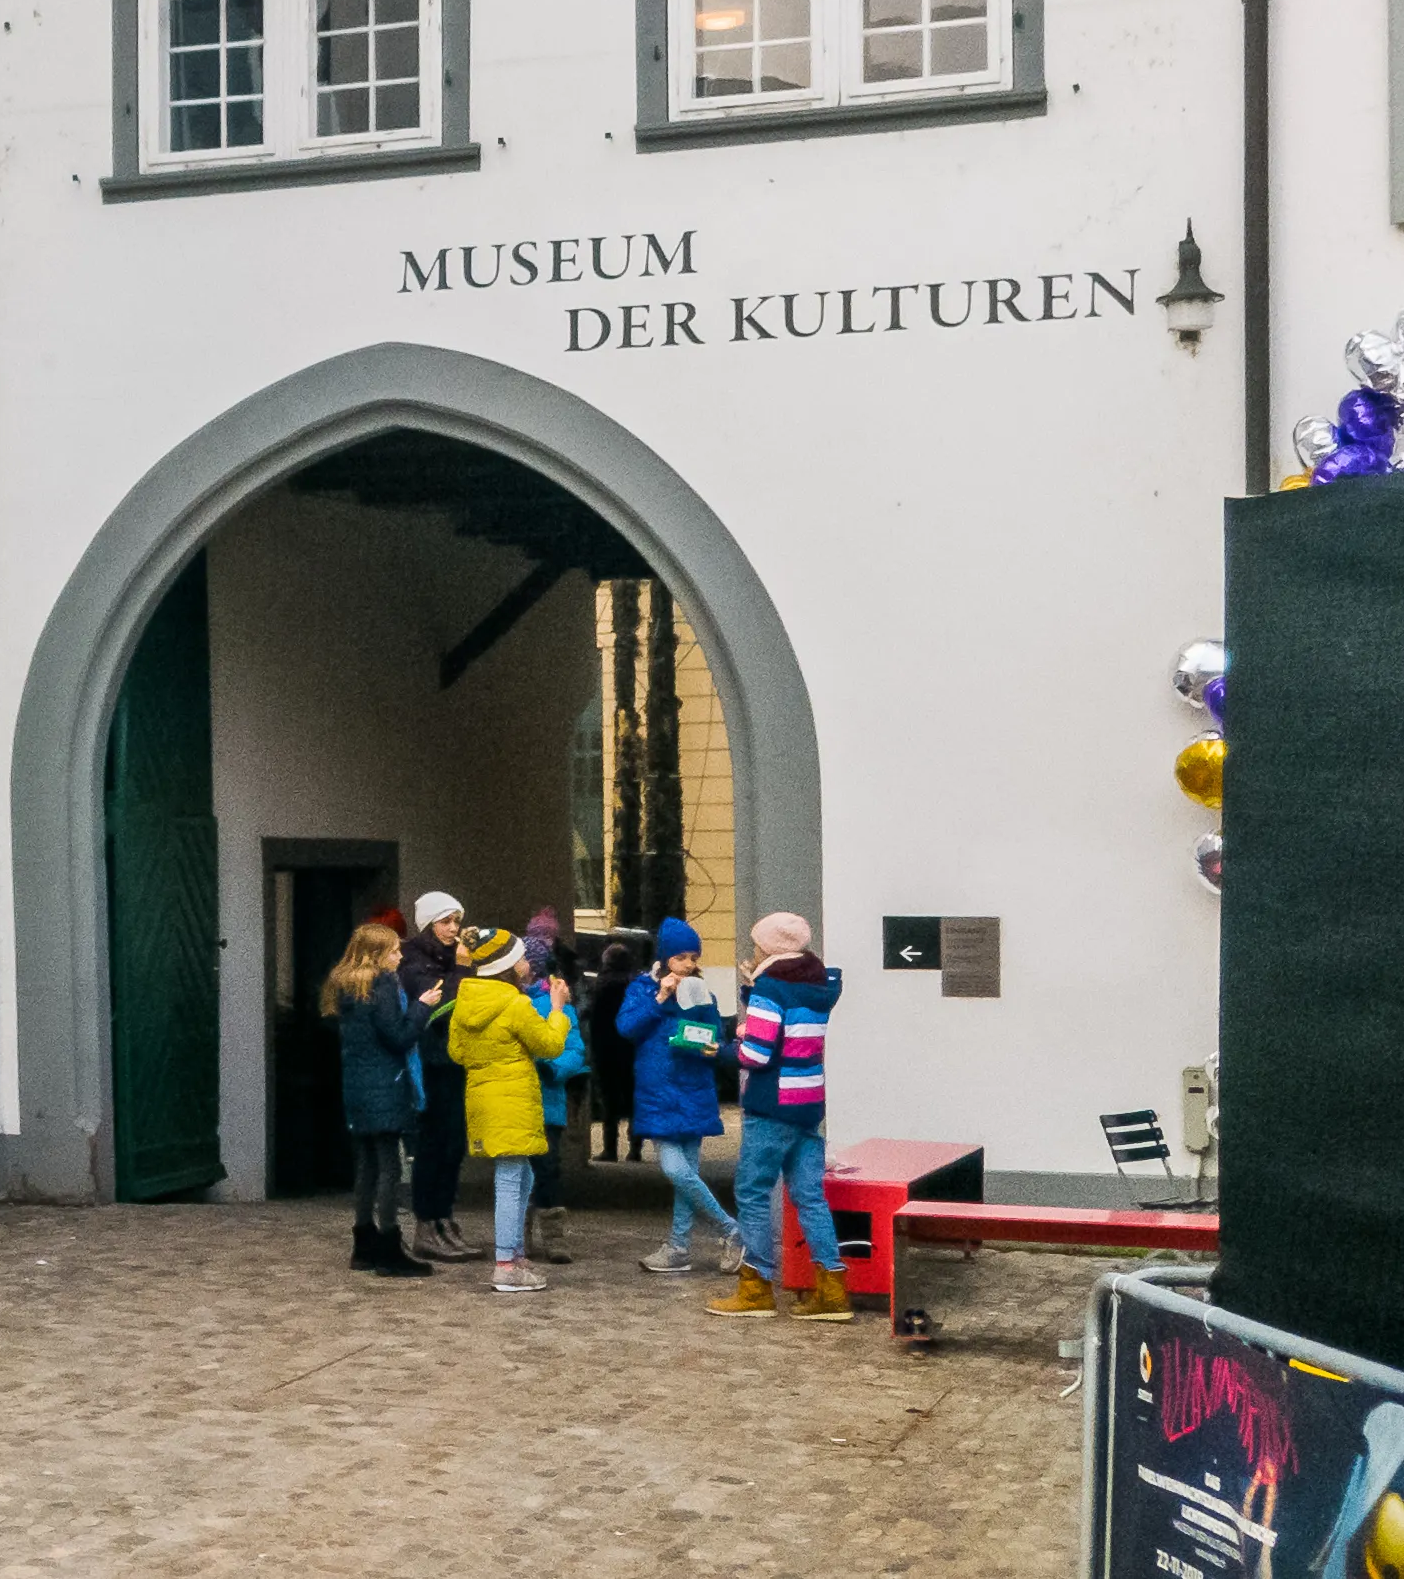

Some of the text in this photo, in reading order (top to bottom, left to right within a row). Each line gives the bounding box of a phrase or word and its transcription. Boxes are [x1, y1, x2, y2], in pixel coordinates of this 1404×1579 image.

[398, 230, 698, 294] MUSEUM
[564, 268, 1140, 352] DER KULTUREN
